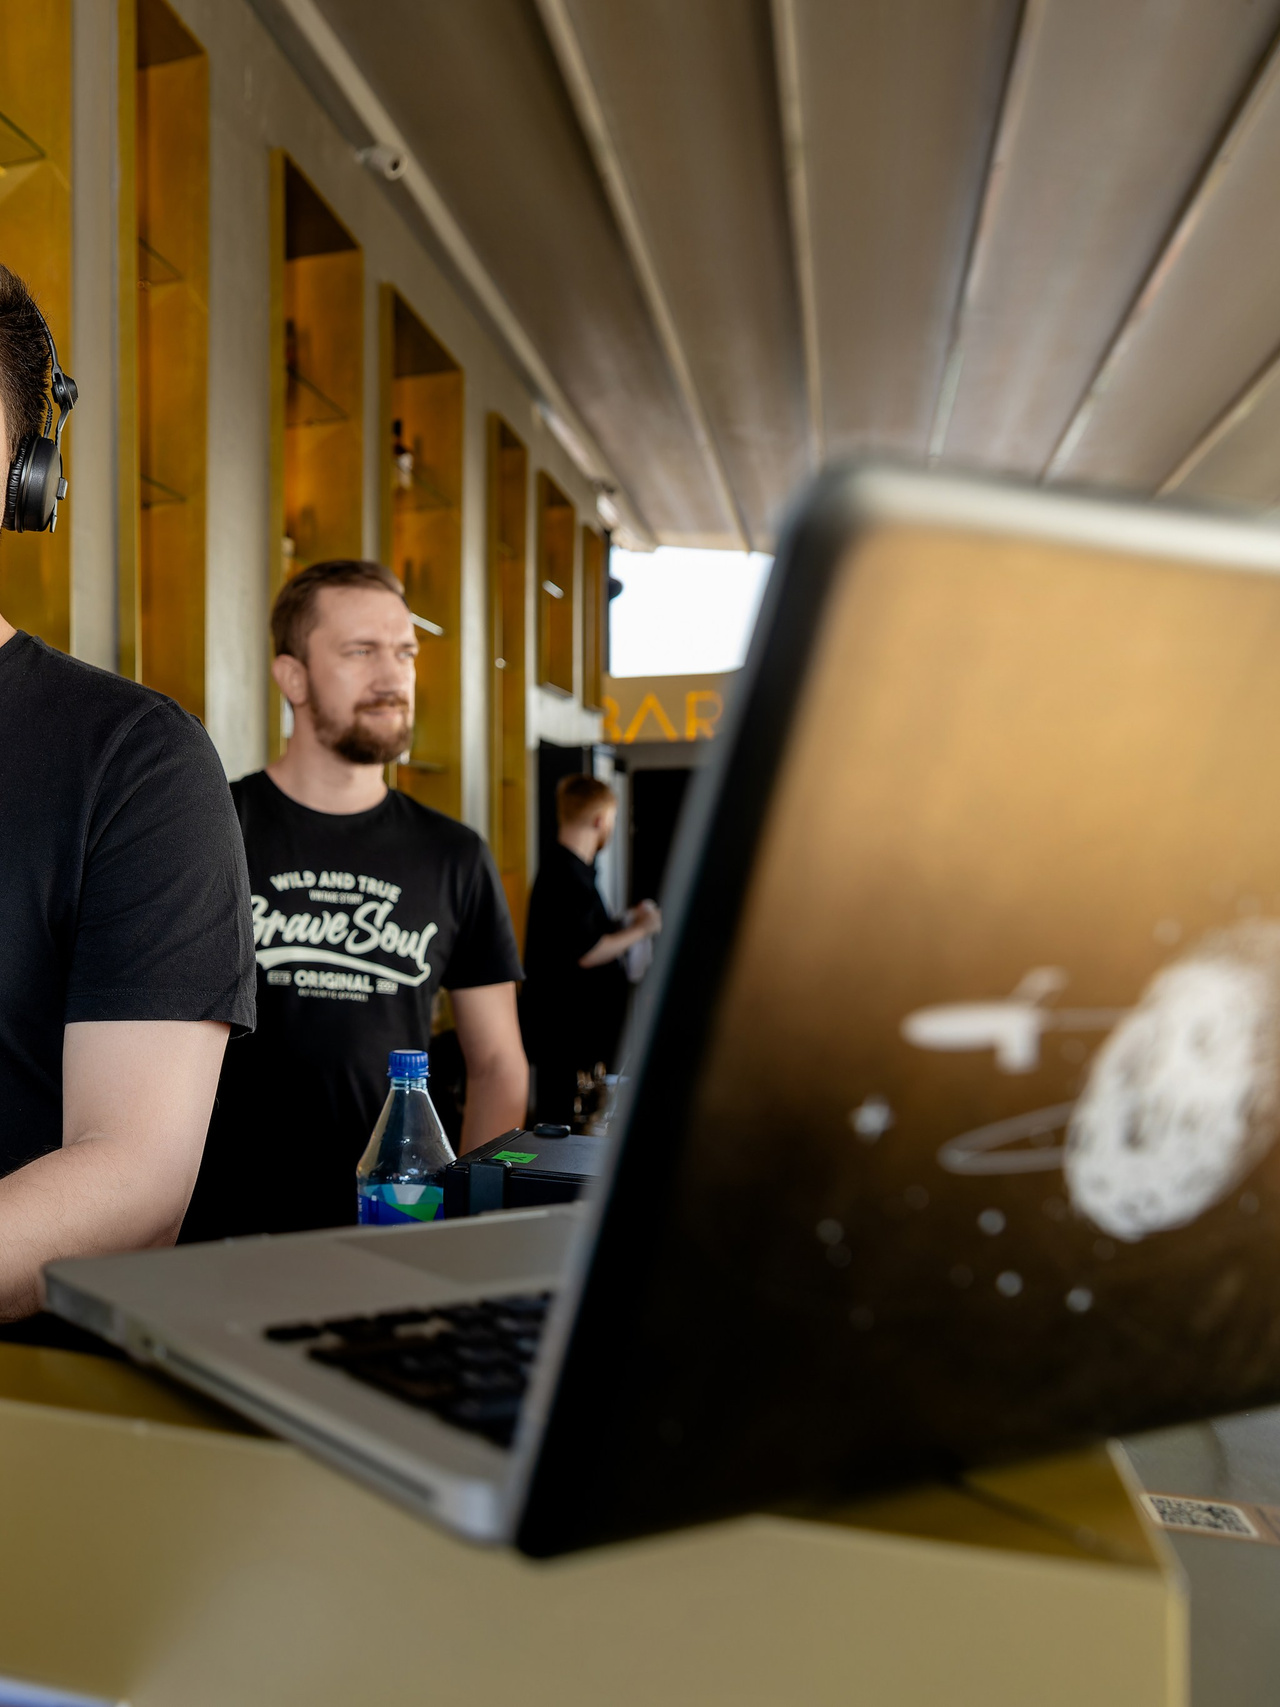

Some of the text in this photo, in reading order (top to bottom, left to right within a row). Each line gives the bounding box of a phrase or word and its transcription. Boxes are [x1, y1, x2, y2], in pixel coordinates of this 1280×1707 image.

[269, 870, 403, 904] WILD AND TRUE
[250, 894, 439, 971] Brave Soul
[293, 968, 375, 994] ORIGINAL
